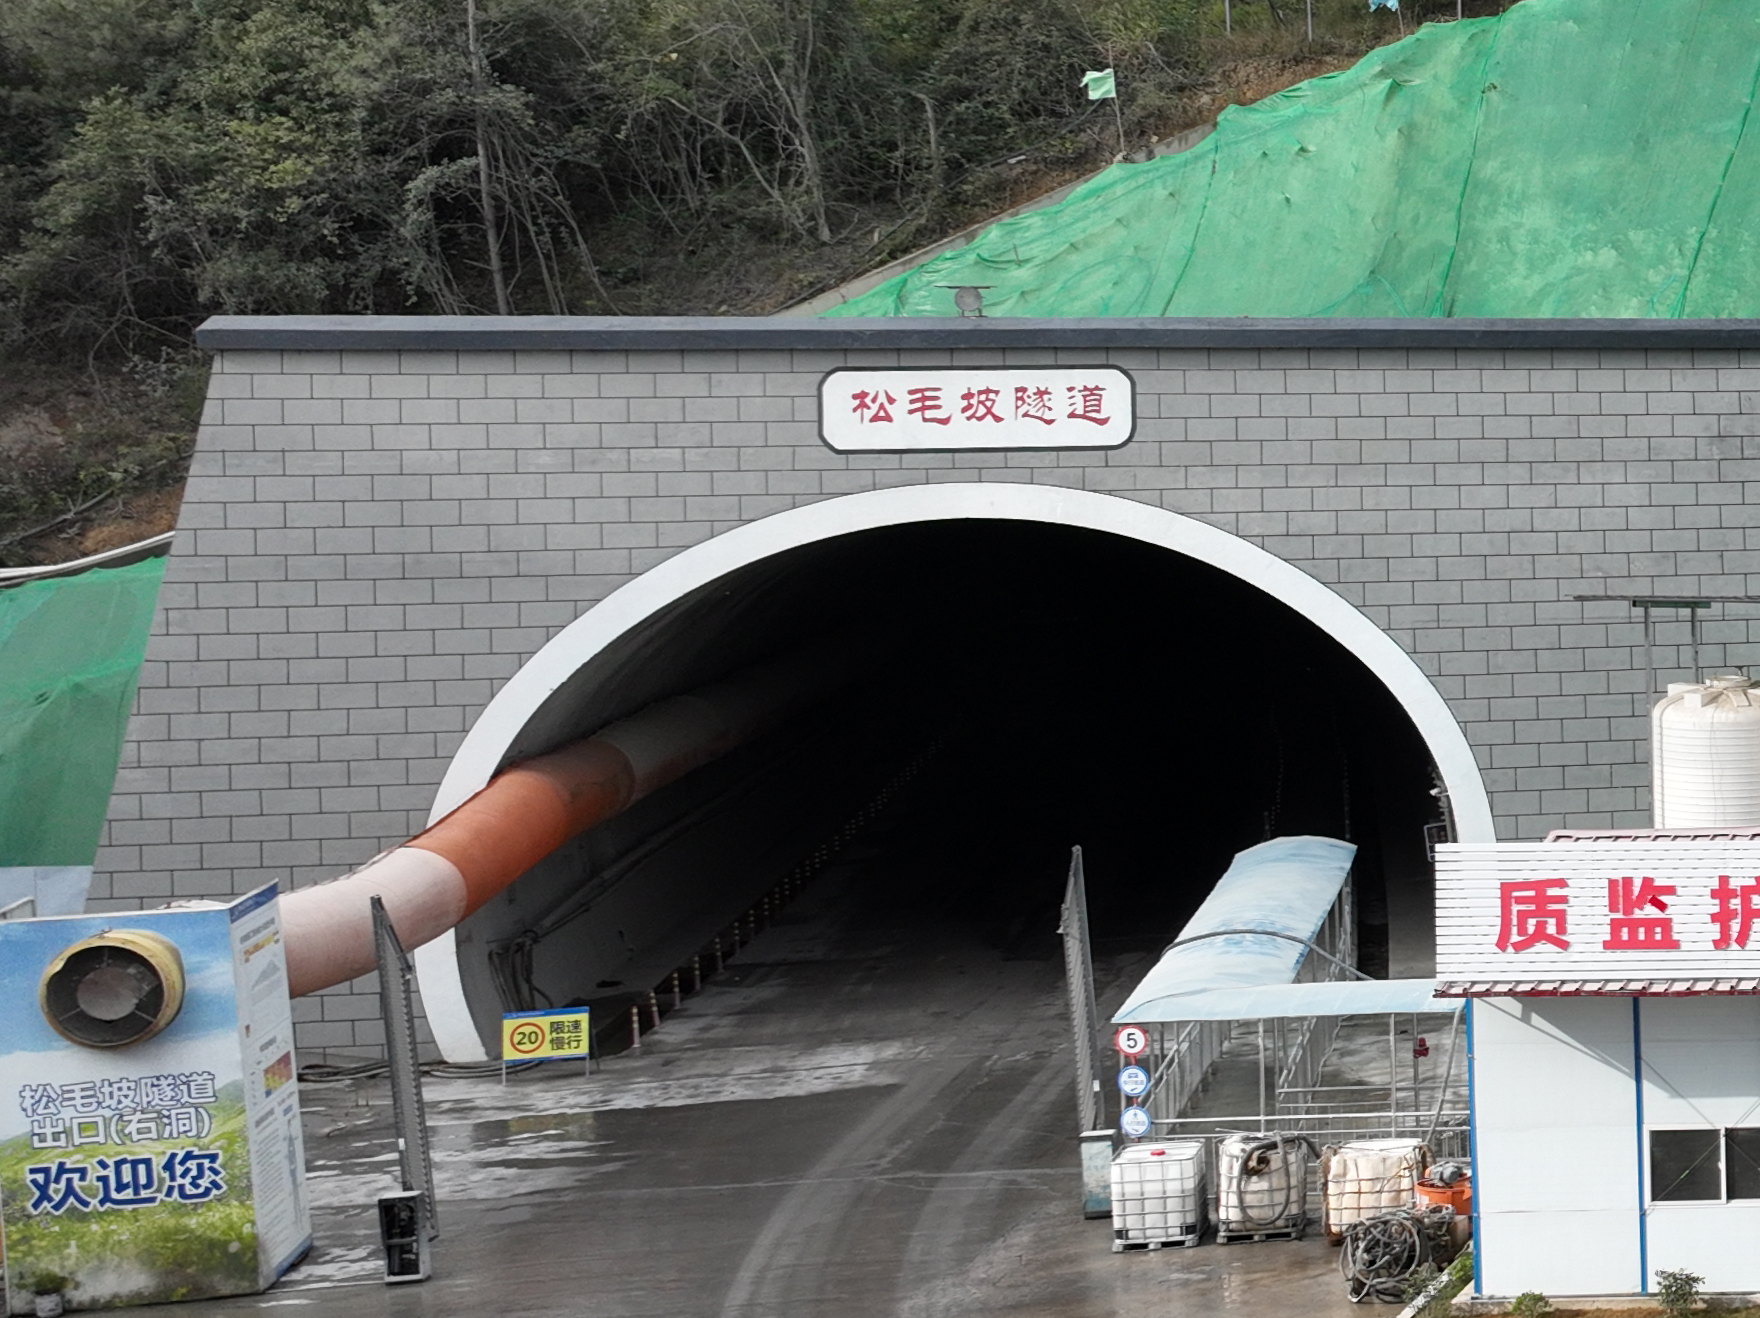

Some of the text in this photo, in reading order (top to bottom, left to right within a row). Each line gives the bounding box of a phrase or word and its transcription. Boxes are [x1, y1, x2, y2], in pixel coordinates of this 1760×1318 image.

[852, 385, 1111, 426] 松毛坡隧道
[516, 1031, 539, 1046] 20
[549, 1019, 582, 1035] 限速
[1126, 1033, 1138, 1048] 5
[549, 1035, 583, 1051] 慢行
[19, 1071, 218, 1117] 松毛坡隧道
[30, 1107, 213, 1150] 出口(右洞)
[28, 1149, 225, 1213] 欢迎您
